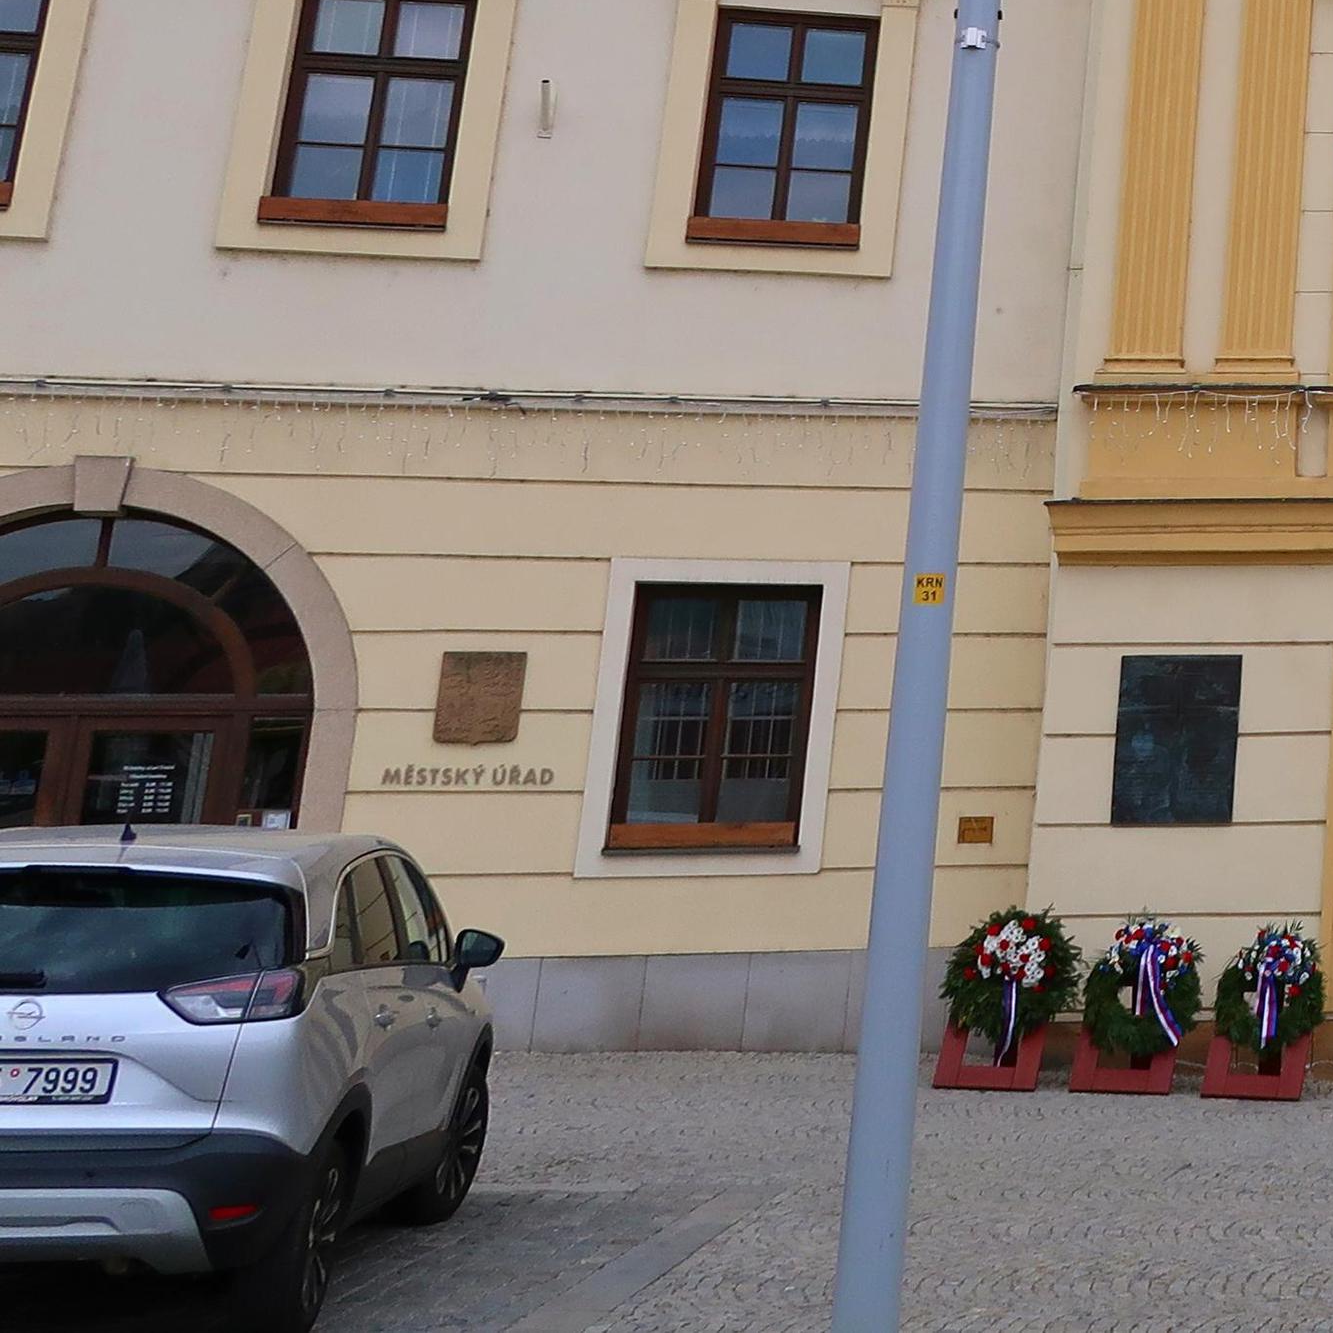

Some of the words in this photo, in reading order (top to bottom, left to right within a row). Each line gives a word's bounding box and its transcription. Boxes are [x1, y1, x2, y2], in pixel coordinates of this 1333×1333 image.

[917, 577, 943, 588] KRN
[922, 590, 937, 602] 31
[381, 764, 485, 786] MĚSTSKÝ
[491, 764, 554, 786] ÚŘAD
[22, 1066, 98, 1095] 7999
